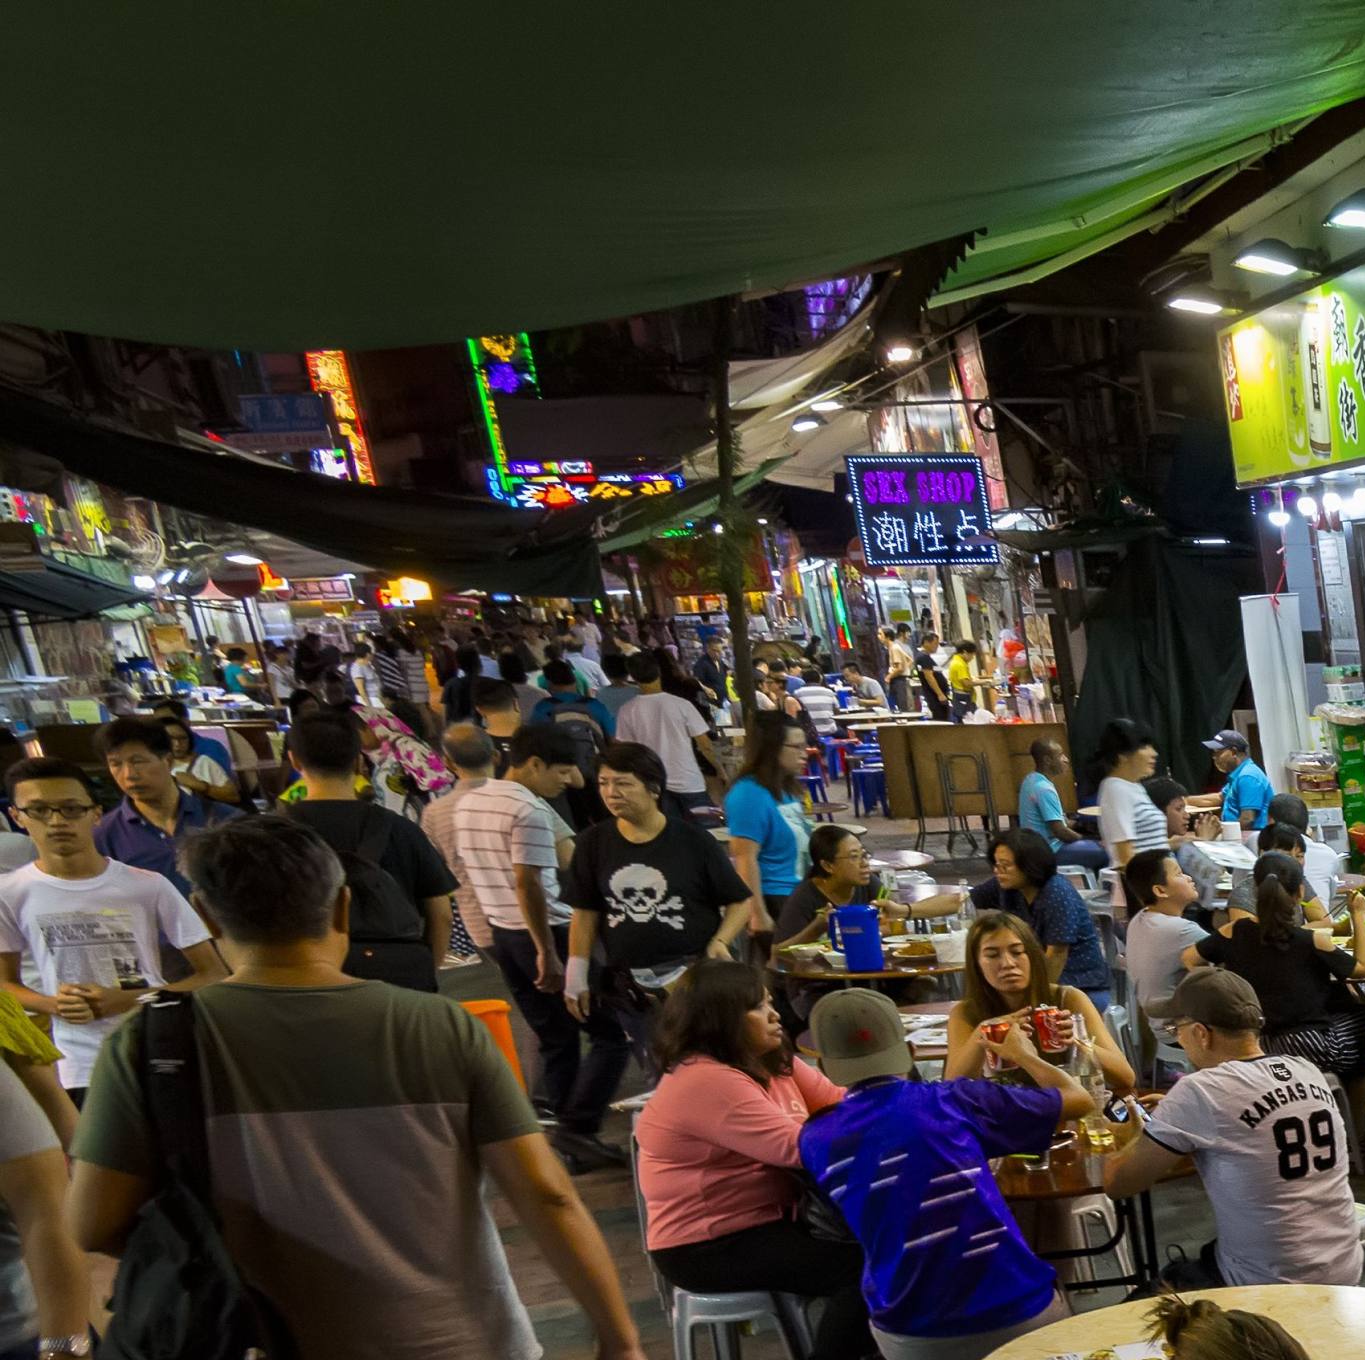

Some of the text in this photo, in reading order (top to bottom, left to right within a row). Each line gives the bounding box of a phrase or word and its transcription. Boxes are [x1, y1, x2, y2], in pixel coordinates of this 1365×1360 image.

[863, 471, 976, 504] SEX SHOP
[1239, 1082, 1308, 1129] KANSAS
[1272, 1108, 1336, 1180] 89
